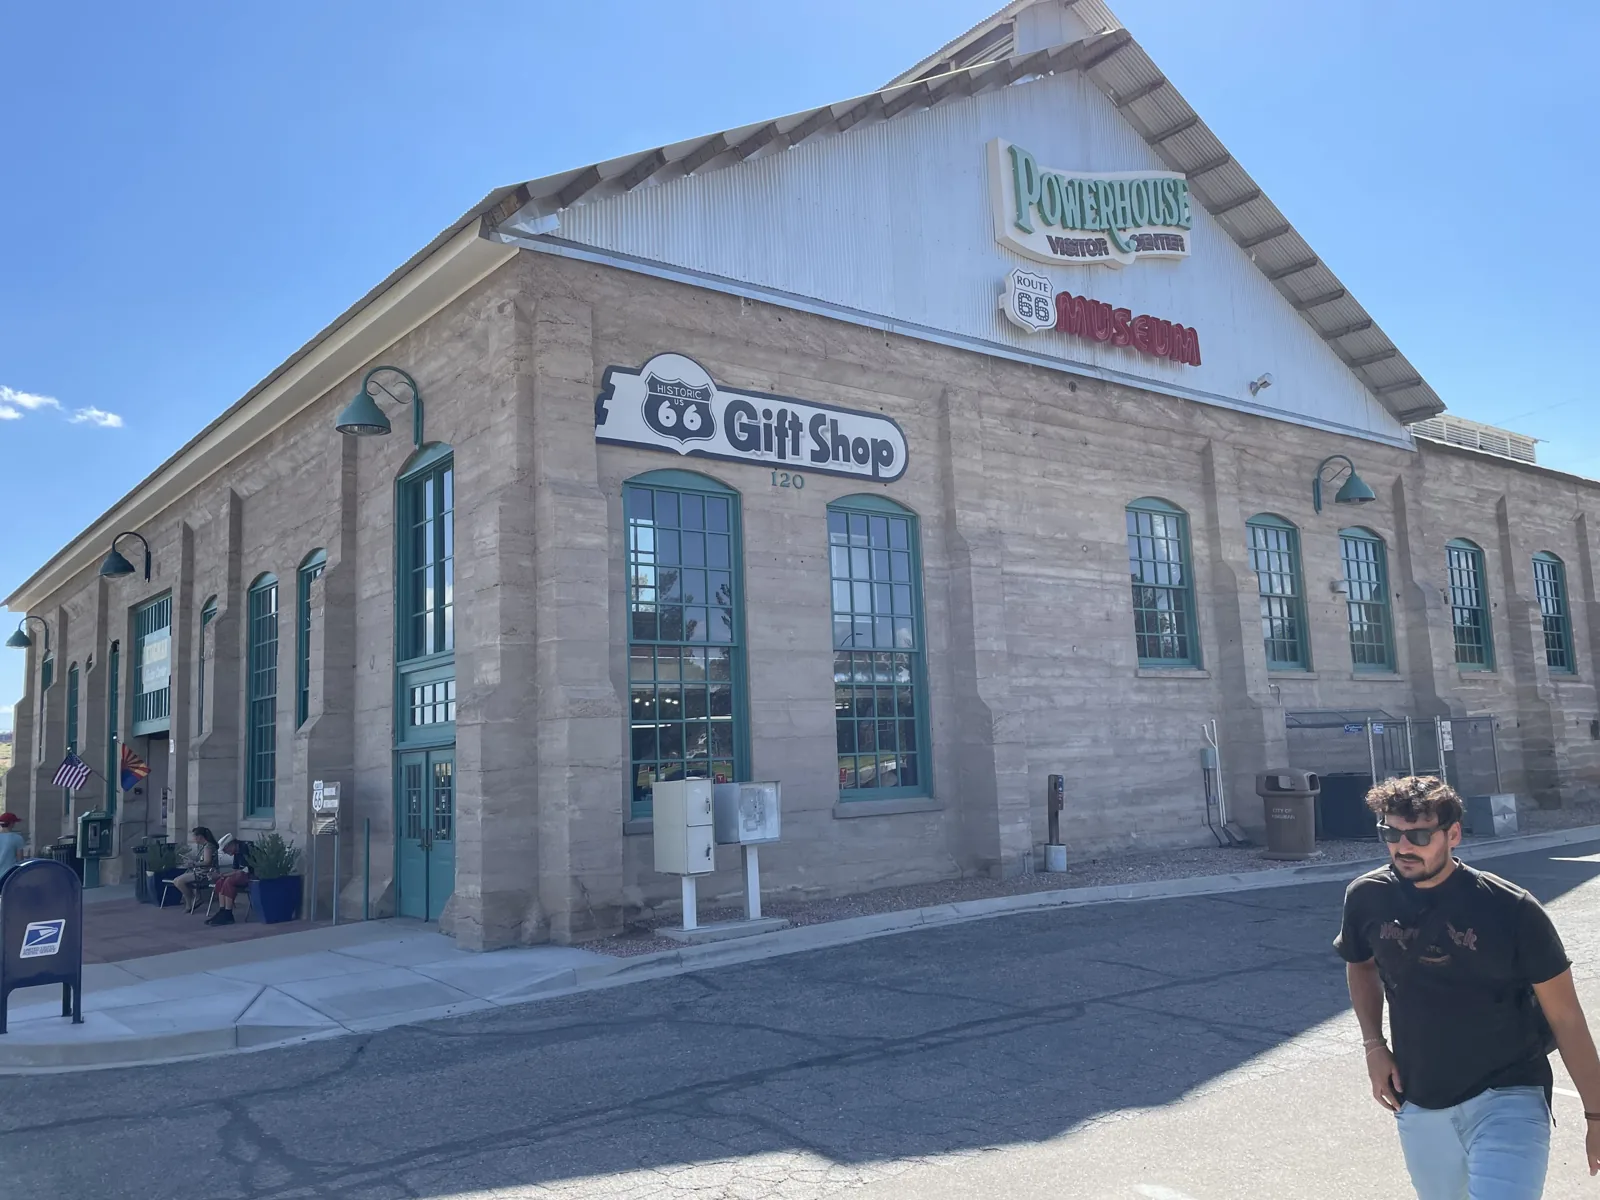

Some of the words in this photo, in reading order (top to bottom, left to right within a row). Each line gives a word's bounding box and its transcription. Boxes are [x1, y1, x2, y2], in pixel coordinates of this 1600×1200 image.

[1008, 144, 1191, 253] POWERHOUSE
[1046, 235, 1110, 257] VISITOR
[1017, 275, 1049, 293] ROUTE
[1018, 292, 1050, 322] 66
[1055, 291, 1202, 366] MUSEUM
[657, 384, 702, 400] HISTORIC
[658, 400, 702, 431] 66
[724, 400, 803, 460] Gift
[809, 413, 895, 478] Shop
[771, 471, 805, 490] 120
